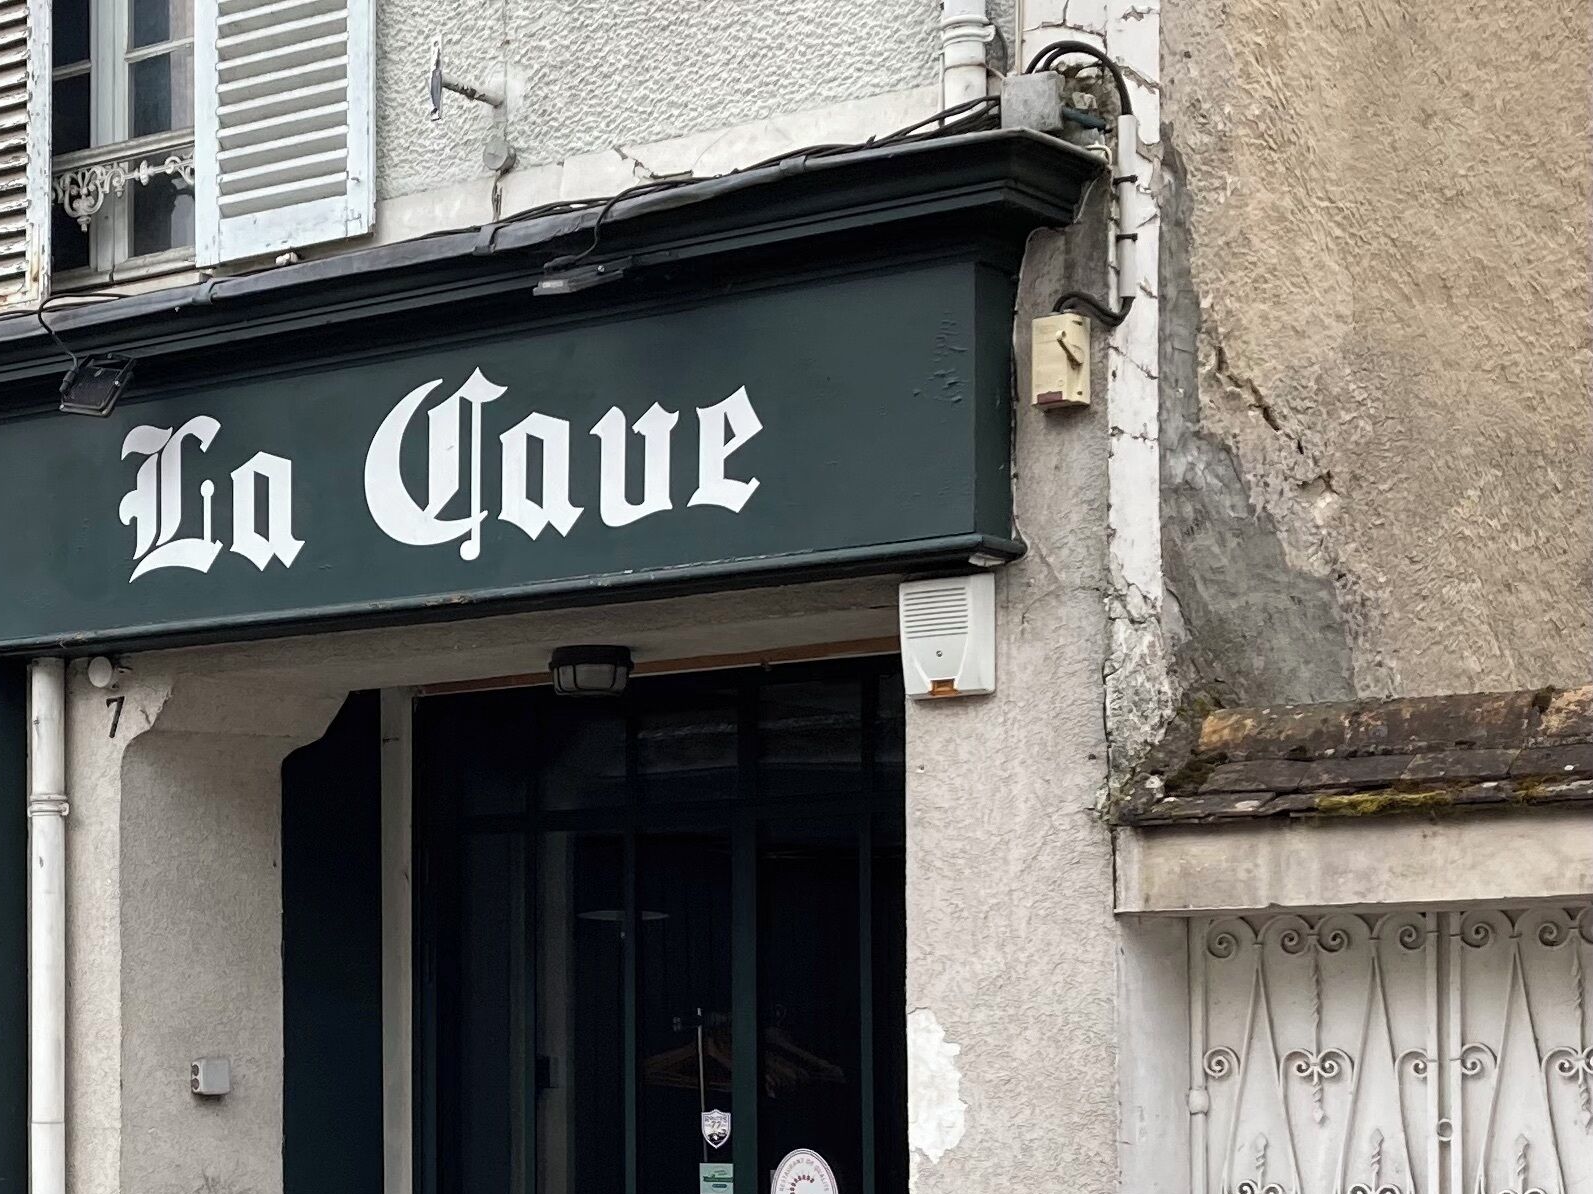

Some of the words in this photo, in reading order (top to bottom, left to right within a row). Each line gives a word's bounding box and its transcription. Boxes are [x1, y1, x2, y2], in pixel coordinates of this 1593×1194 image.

[119, 416, 305, 583] La
[365, 367, 763, 560] Cave
[105, 695, 125, 739] 7
